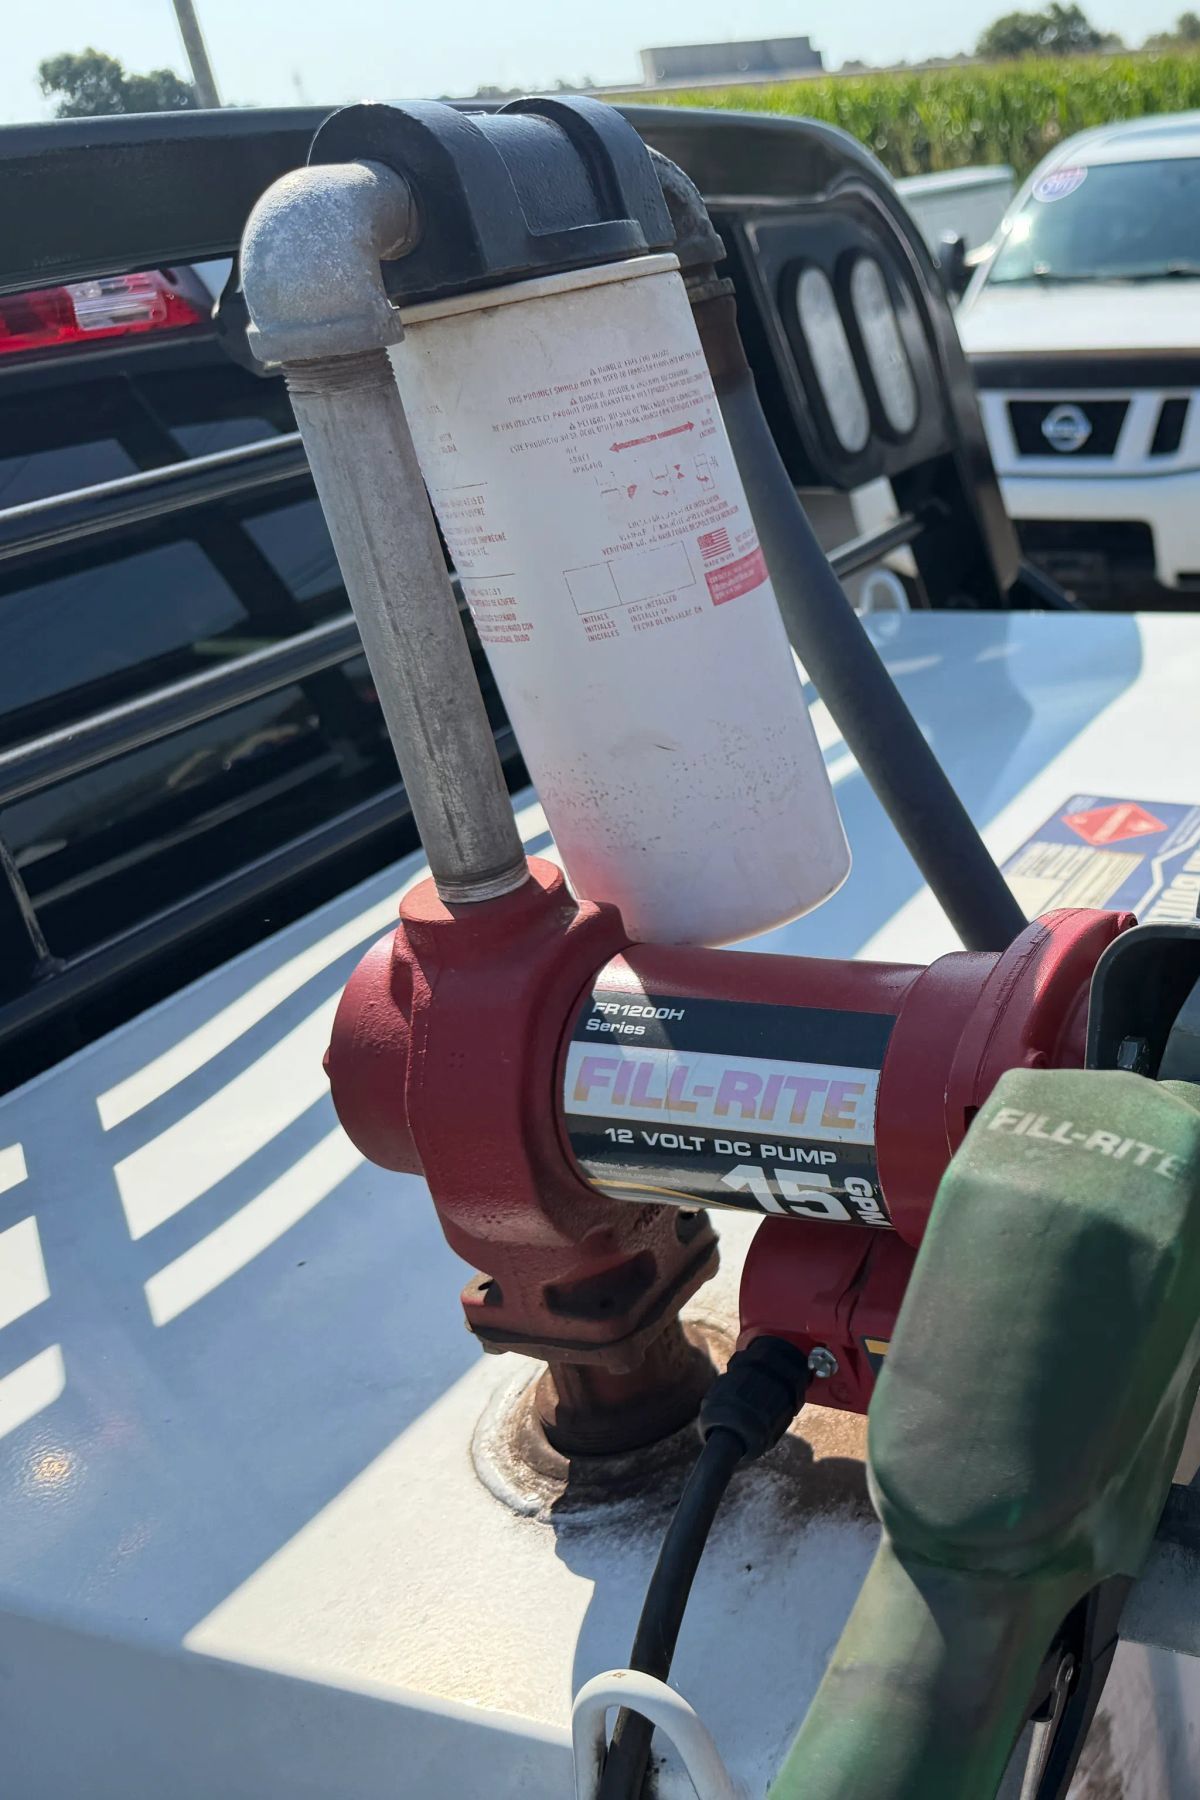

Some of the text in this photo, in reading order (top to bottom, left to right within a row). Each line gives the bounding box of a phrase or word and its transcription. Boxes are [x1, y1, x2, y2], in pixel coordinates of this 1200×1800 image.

[585, 1018, 646, 1036] Series
[591, 1001, 685, 1021] FR1200H
[573, 1055, 867, 1130] FILL-RITE
[604, 1127, 838, 1166] 12 VOLT DC PUMP
[986, 1107, 1181, 1182] FILL-RITE
[720, 1164, 852, 1221] 15
[843, 1176, 891, 1227] GPM
